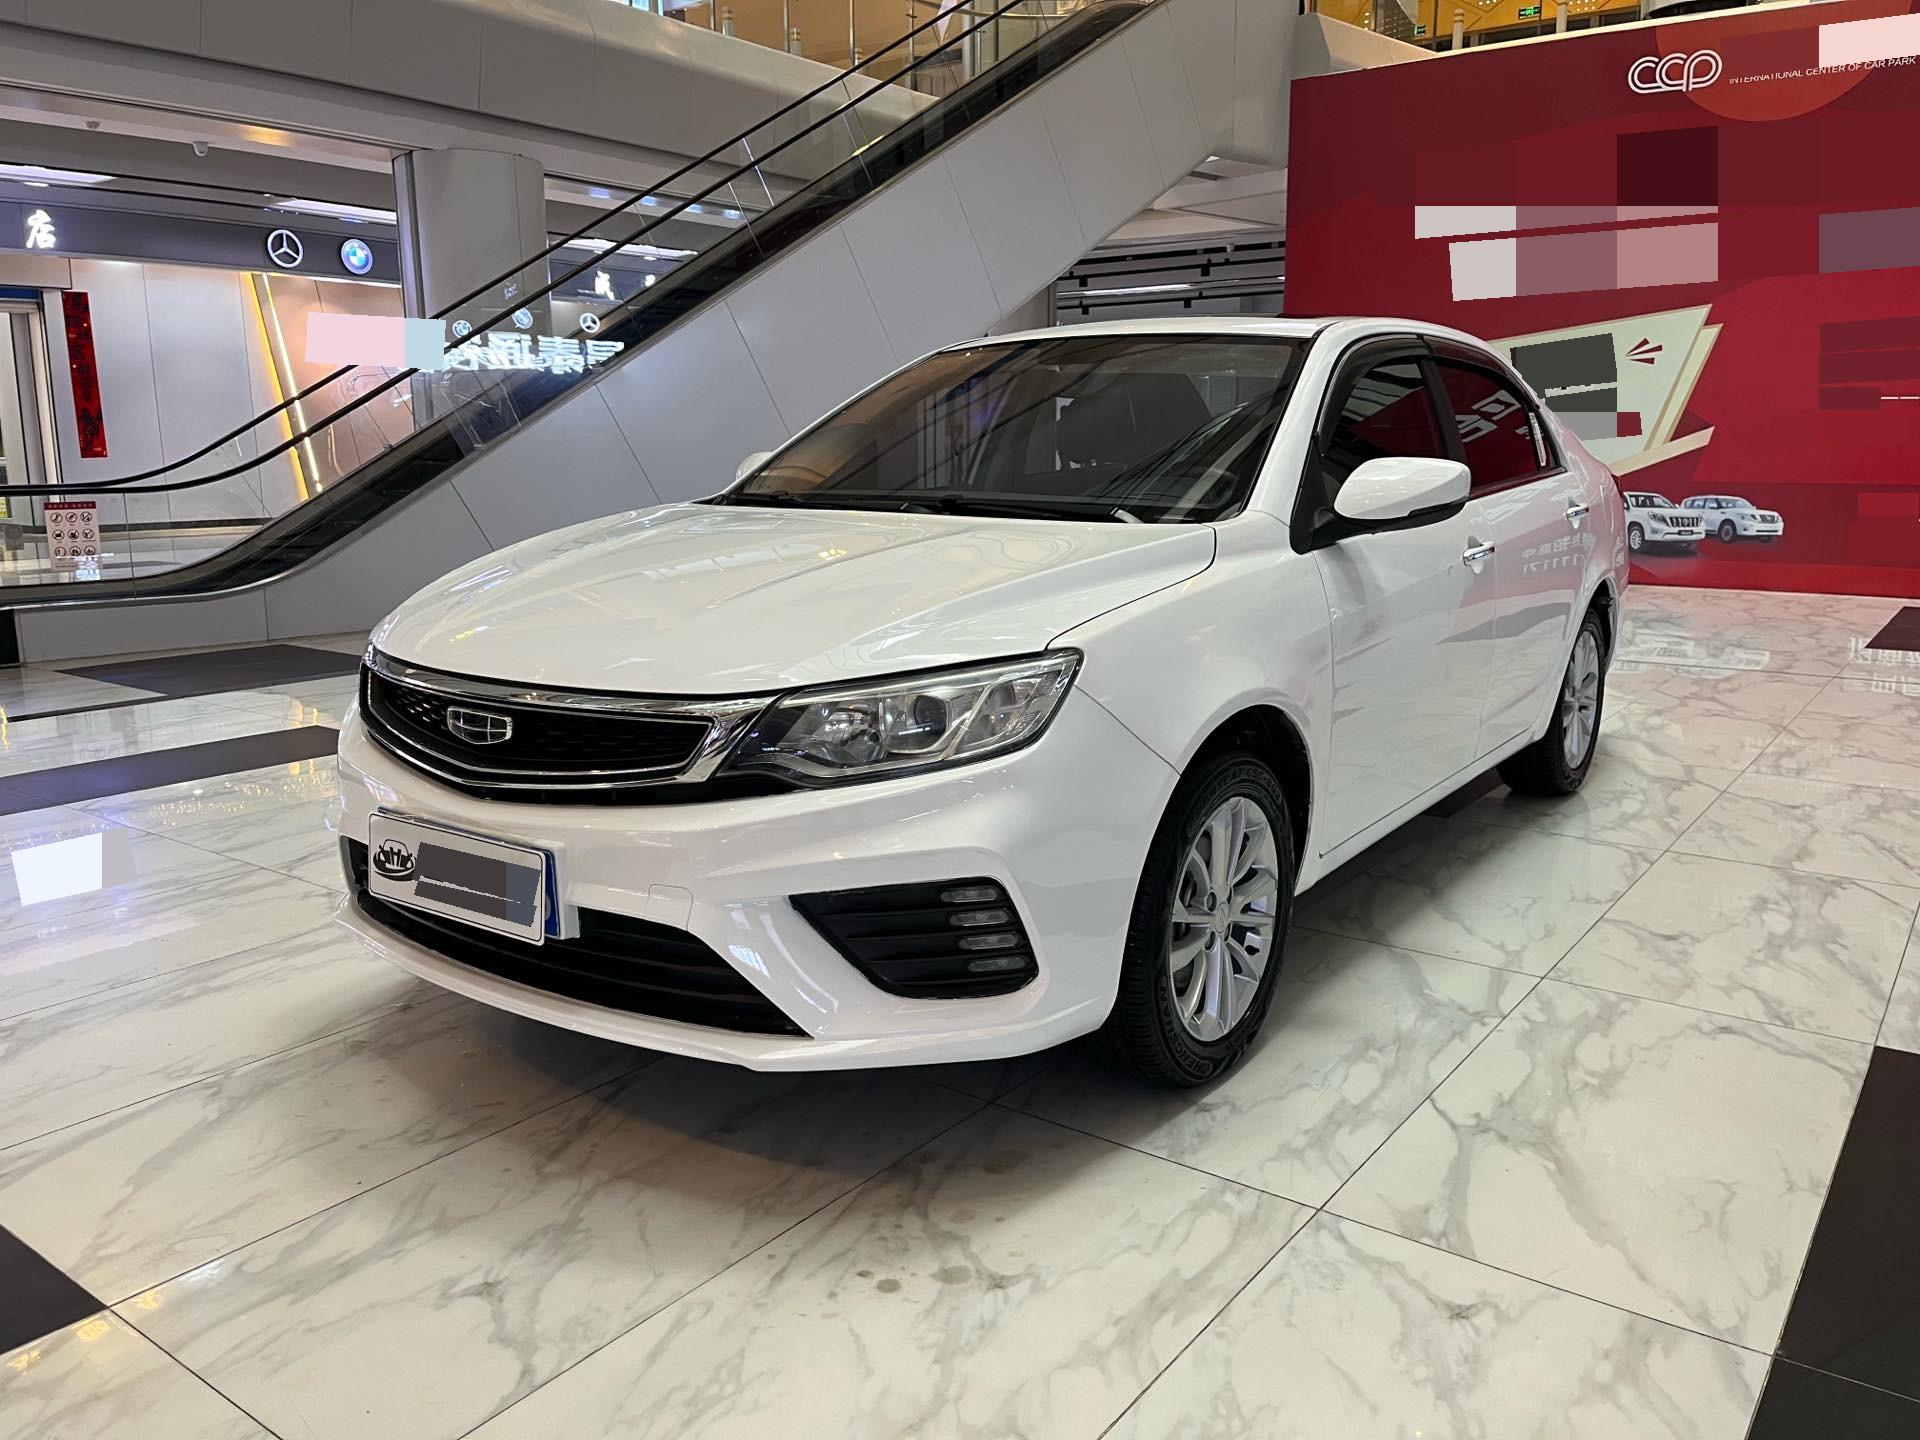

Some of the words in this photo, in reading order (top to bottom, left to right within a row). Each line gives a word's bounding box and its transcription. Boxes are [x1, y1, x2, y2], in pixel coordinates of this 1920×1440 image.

[1805, 64, 1846, 77] CENTER
[1847, 62, 1862, 72] OF
[1864, 60, 1886, 71] CAR
[1887, 55, 1917, 68] PARK
[26, 209, 57, 249] 店
